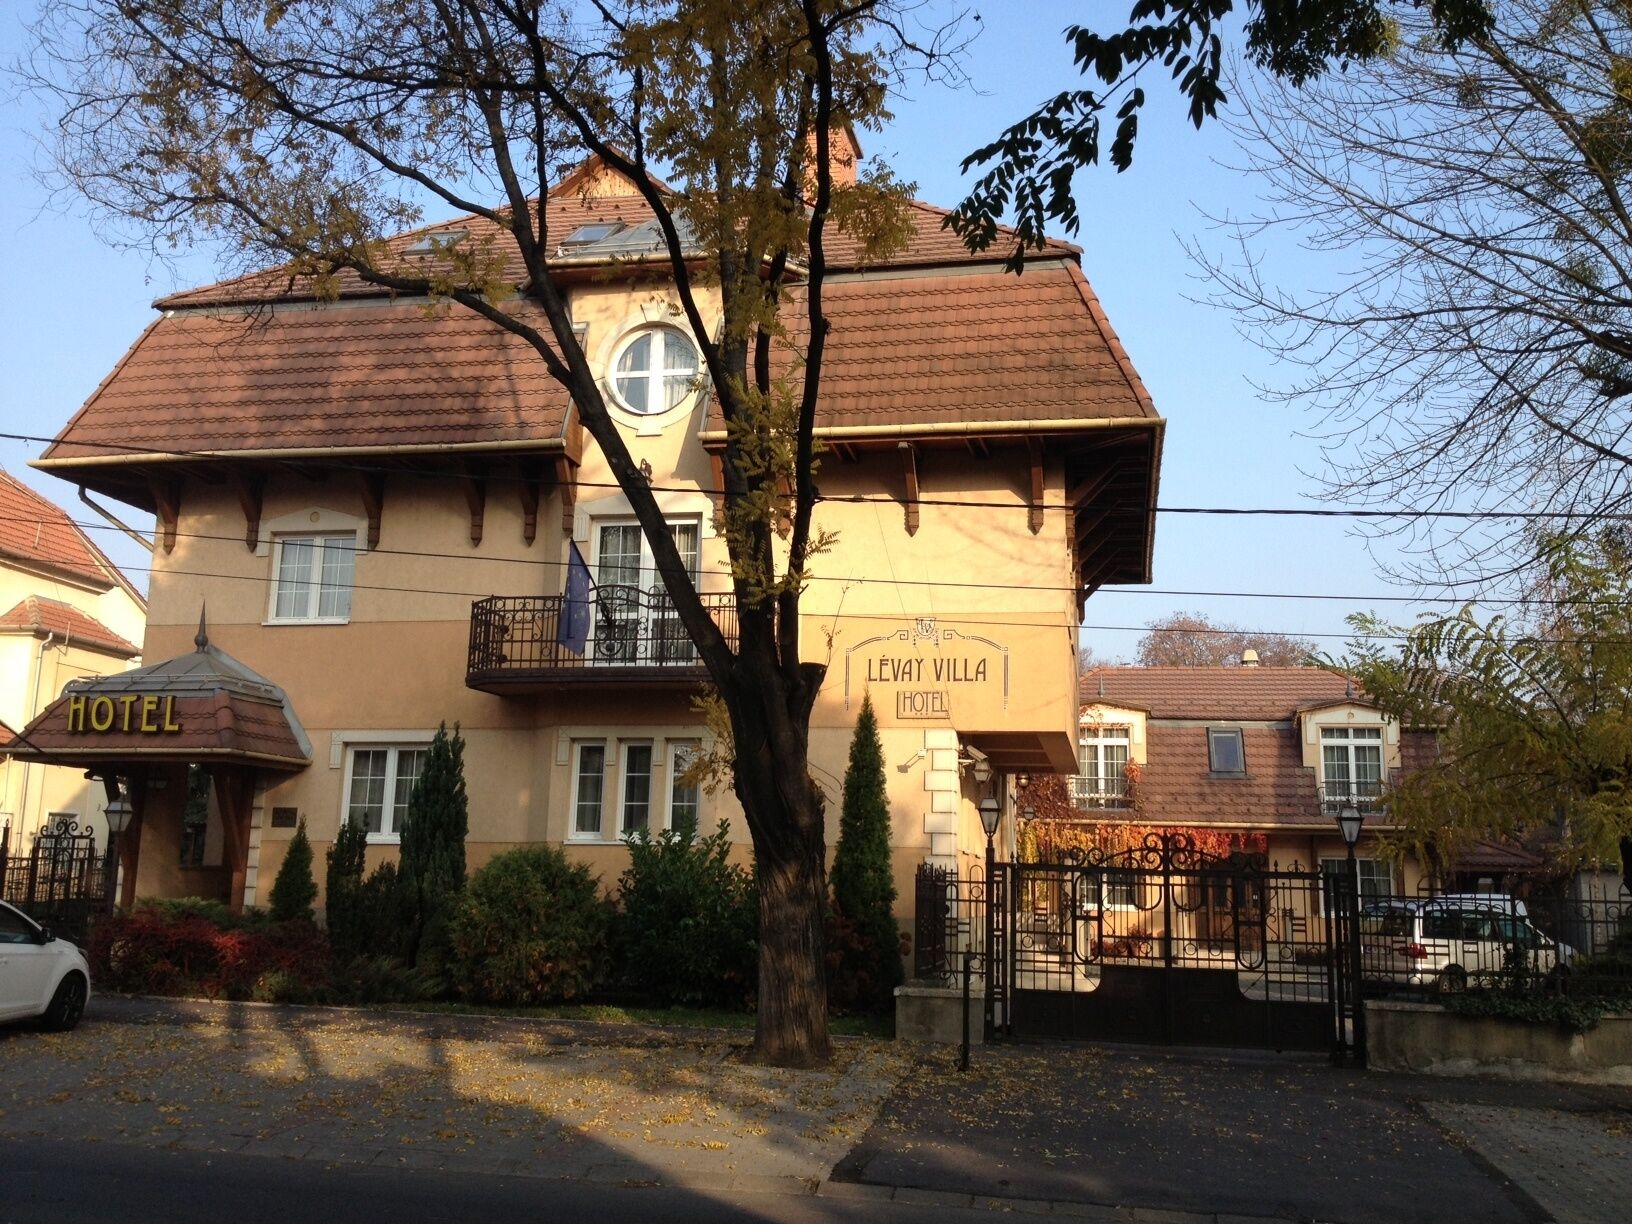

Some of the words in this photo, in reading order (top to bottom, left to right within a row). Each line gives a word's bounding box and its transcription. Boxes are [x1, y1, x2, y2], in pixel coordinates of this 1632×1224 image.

[867, 654, 924, 682] LÉVAY
[933, 657, 987, 682] VILLA
[67, 694, 182, 732] HOTEL
[903, 690, 949, 713] HOTEL
